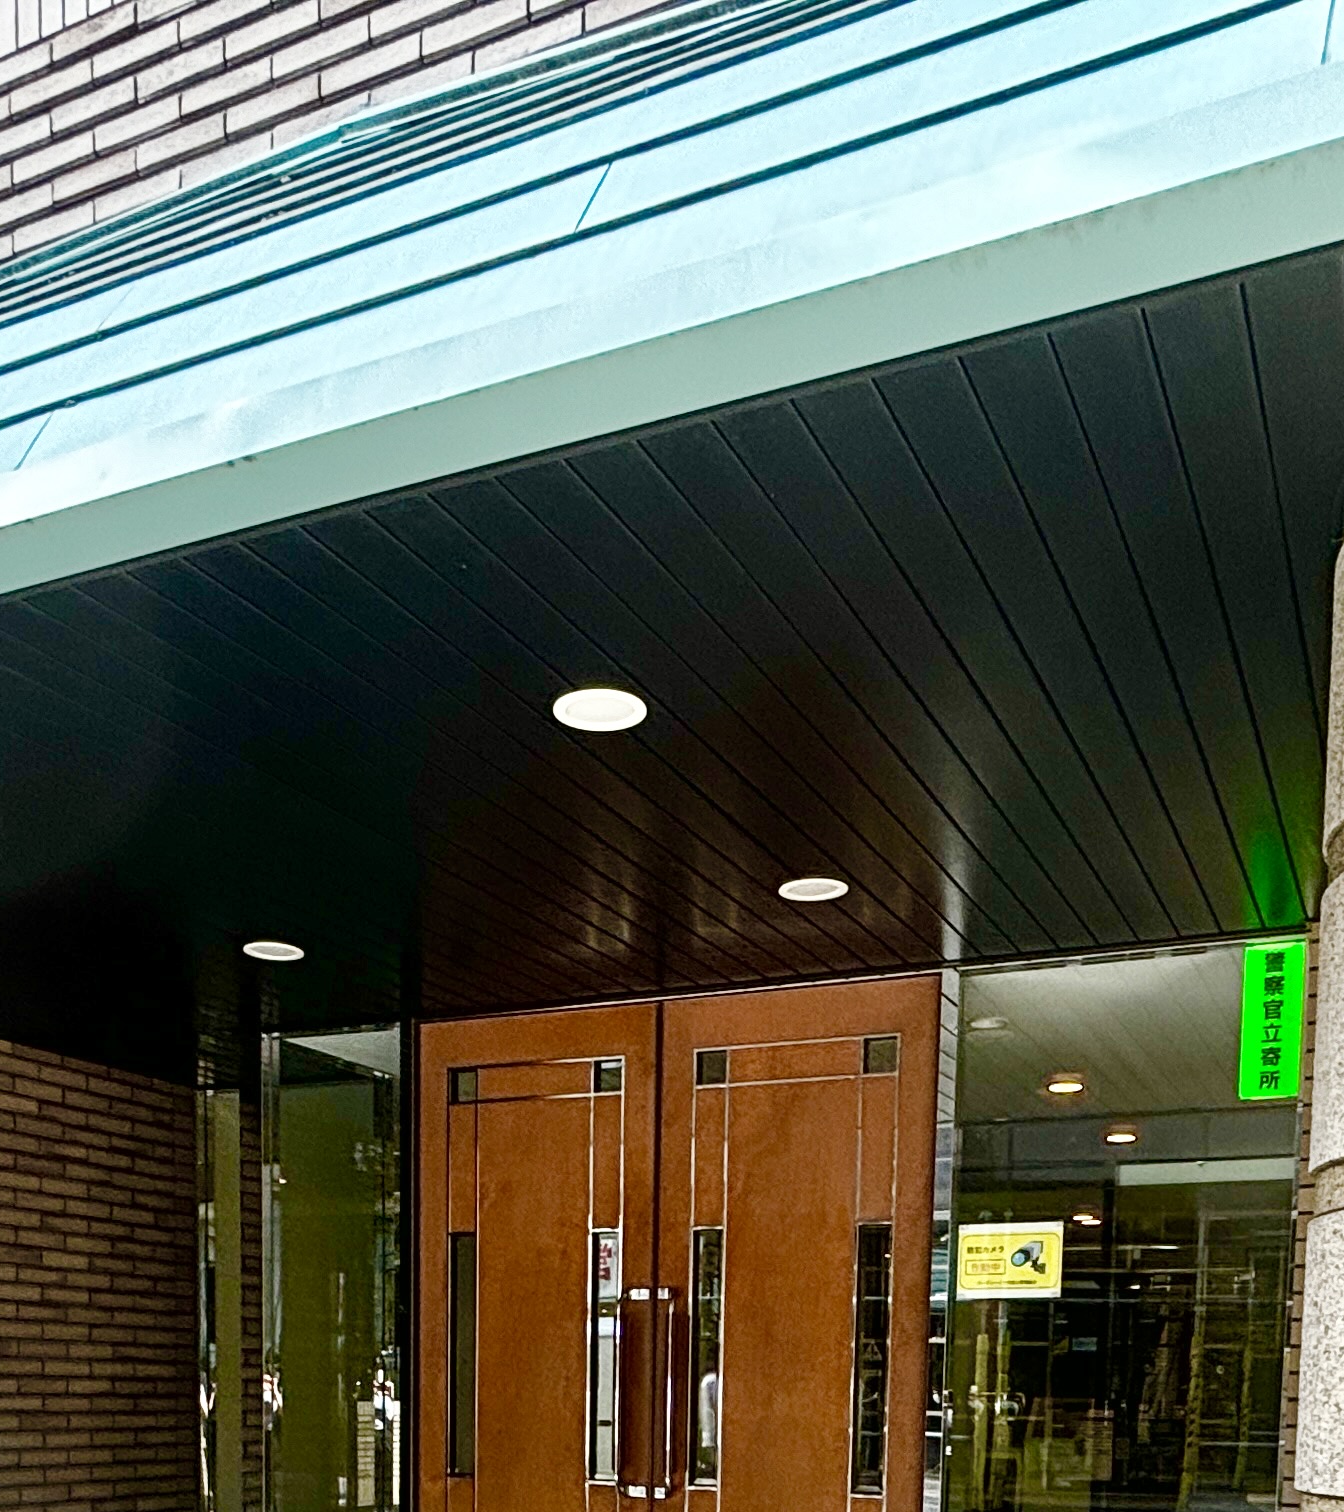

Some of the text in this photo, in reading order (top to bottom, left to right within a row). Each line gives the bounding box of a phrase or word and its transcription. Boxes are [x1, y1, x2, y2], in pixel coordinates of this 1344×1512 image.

[1258, 951, 1286, 1091] 警察官立寄所
